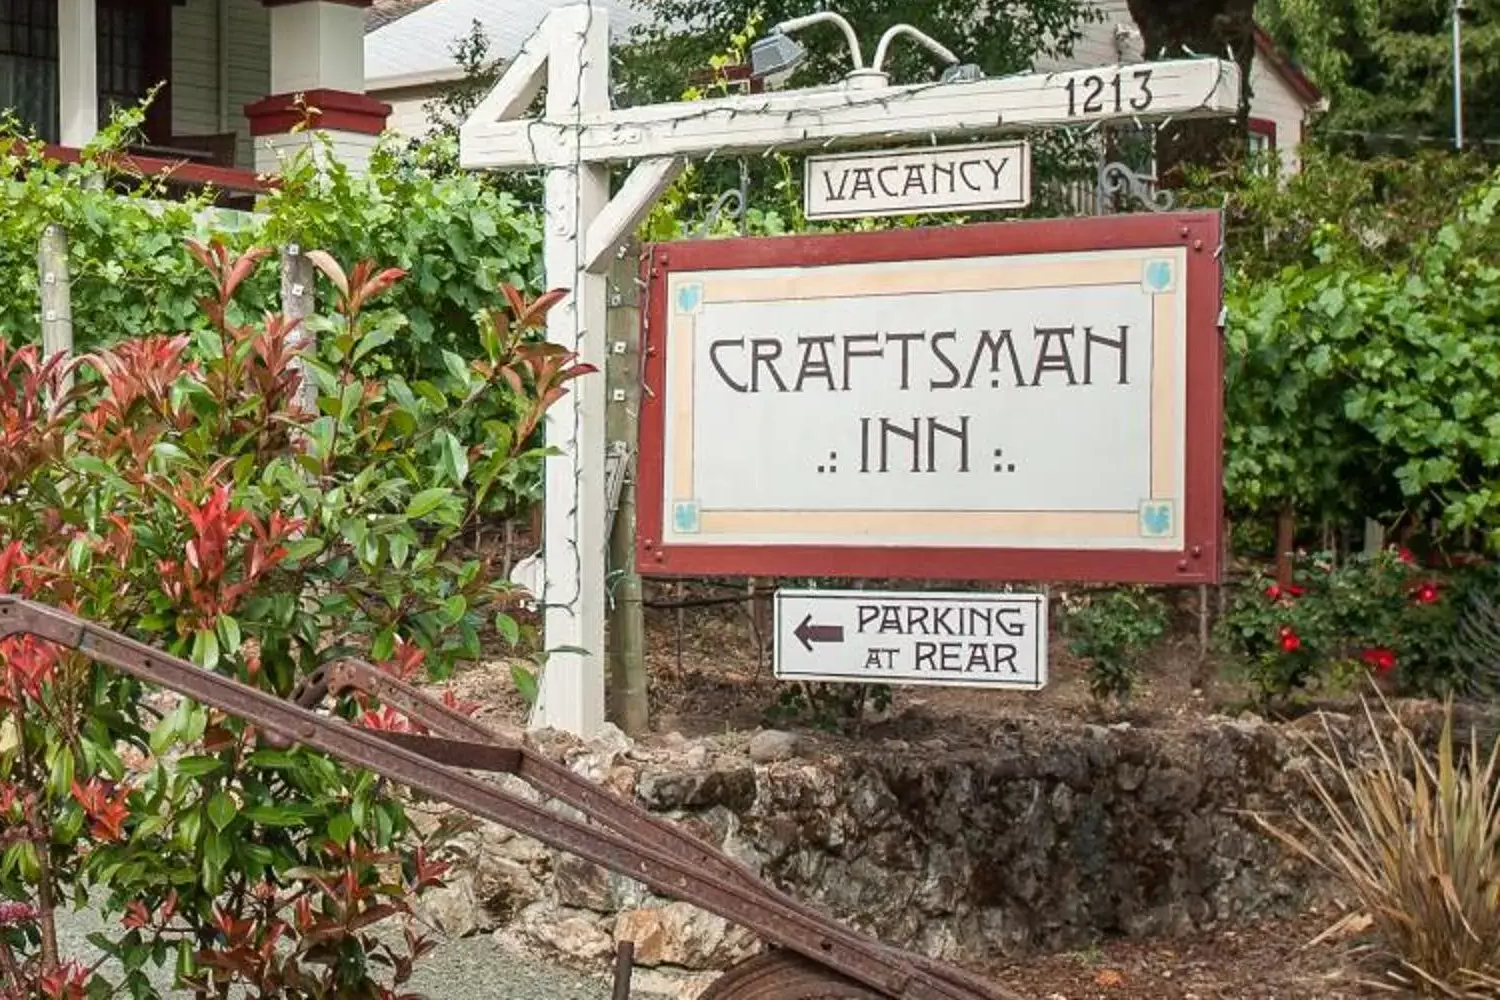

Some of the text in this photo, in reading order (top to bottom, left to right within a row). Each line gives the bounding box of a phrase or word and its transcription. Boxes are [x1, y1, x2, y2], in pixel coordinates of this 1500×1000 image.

[1064, 71, 1154, 116] 1213
[824, 156, 1010, 202] VACANCY
[708, 325, 1131, 393] CRAFTSMAN
[859, 416, 971, 473] INN
[856, 604, 1026, 638] PARKING
[864, 642, 1018, 673] AT REAR
